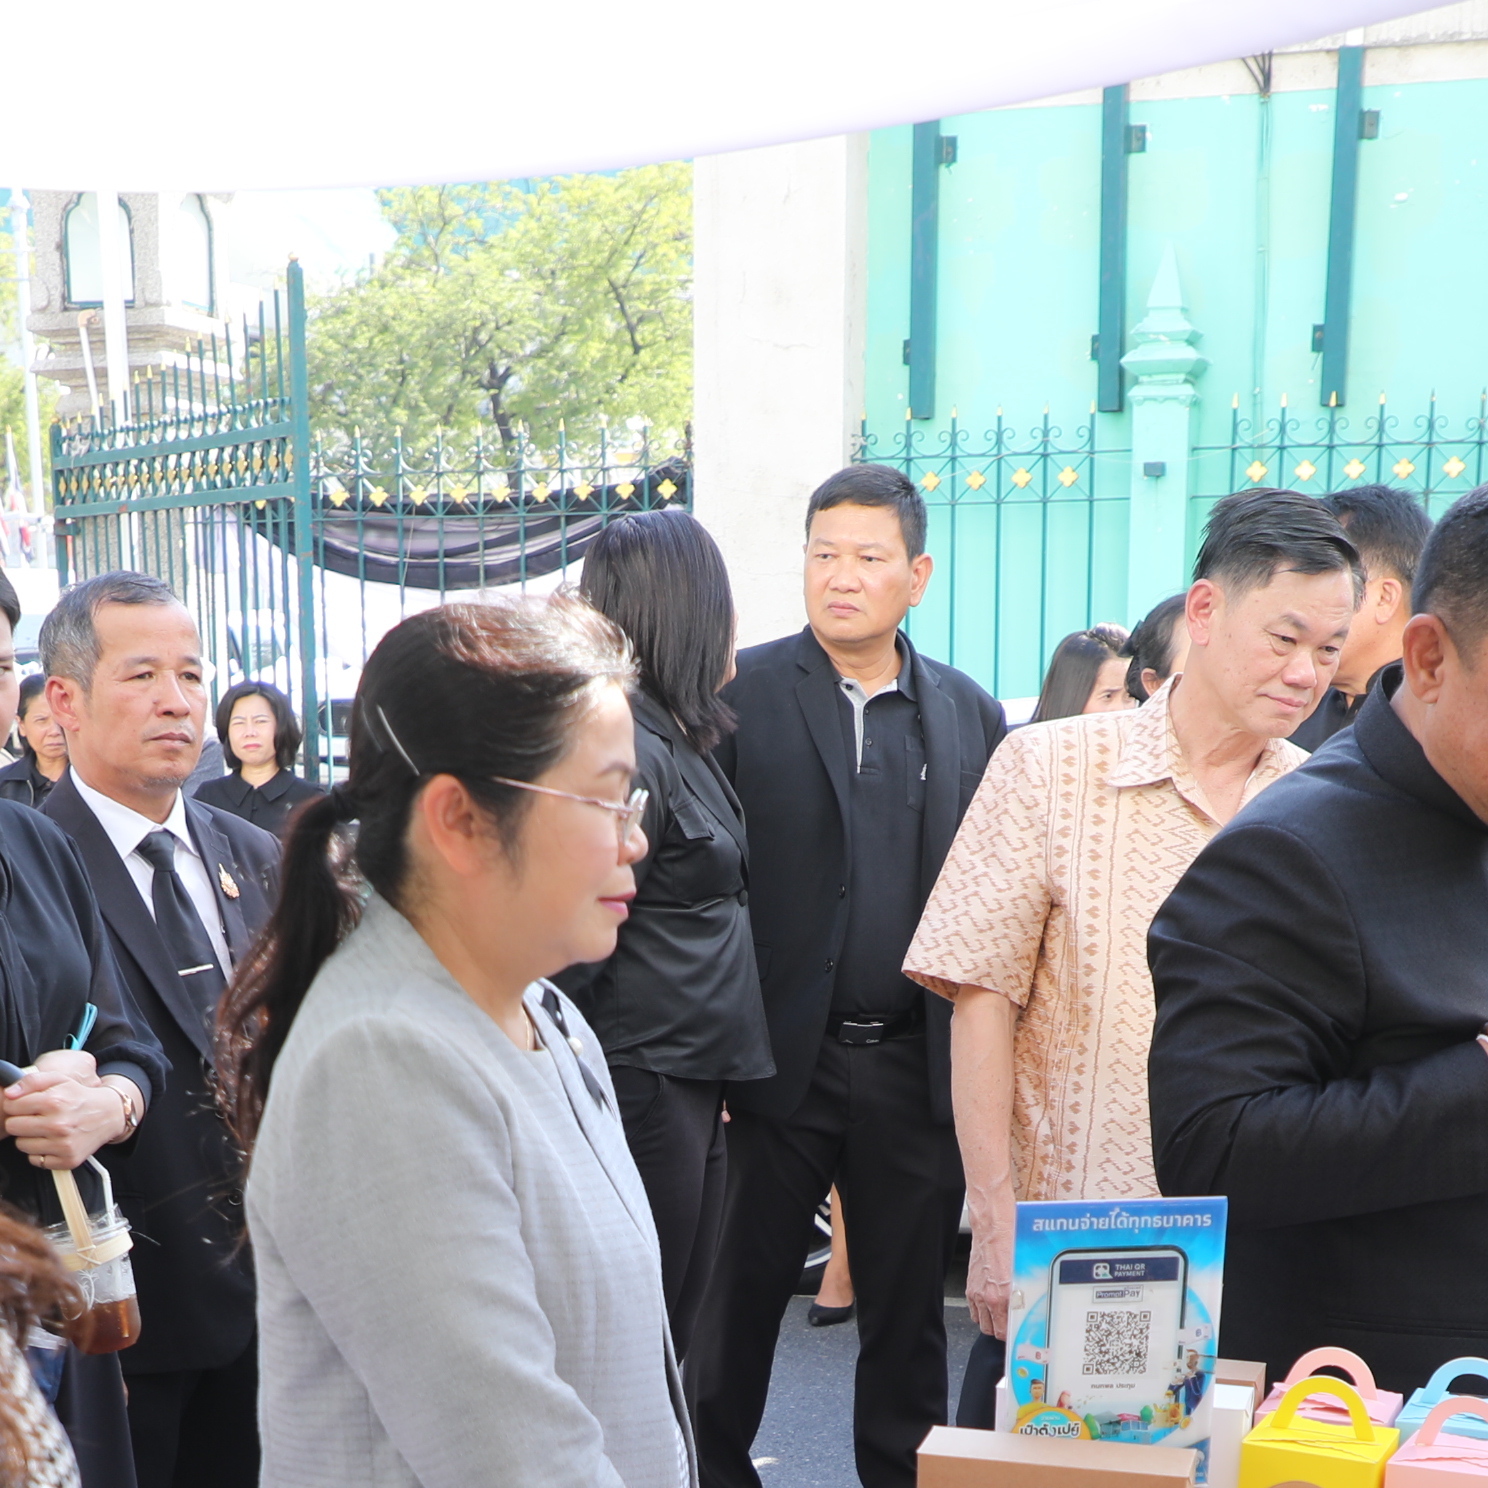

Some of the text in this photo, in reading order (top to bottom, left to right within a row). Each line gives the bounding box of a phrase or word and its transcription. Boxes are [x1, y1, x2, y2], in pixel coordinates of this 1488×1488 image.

[1032, 1206, 1212, 1234] สแกนจ่ายได้ทุกธนาคาร
[1115, 1263, 1133, 1271] THAI
